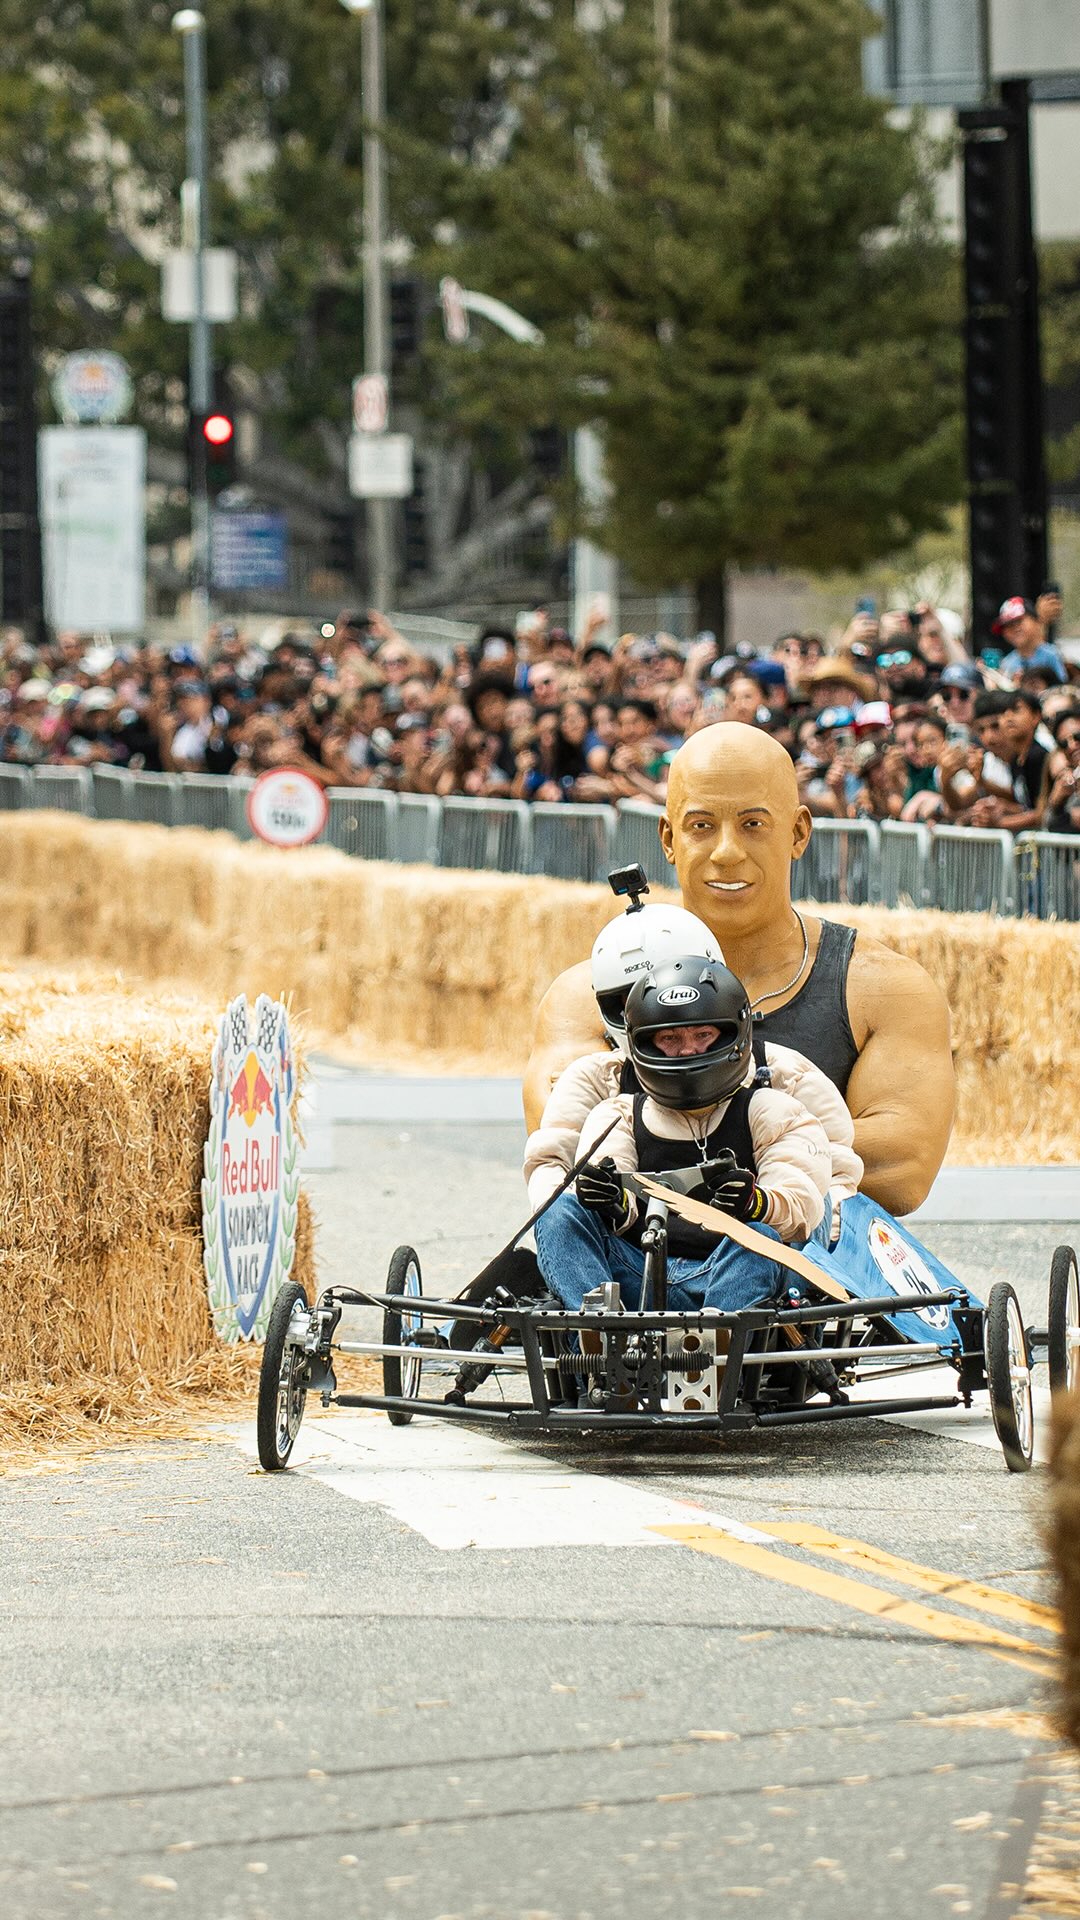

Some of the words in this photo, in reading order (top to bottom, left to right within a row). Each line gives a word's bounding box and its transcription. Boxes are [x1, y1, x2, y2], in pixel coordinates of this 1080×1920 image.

[662, 989, 692, 1002] Arai
[222, 1139, 248, 1195] Red
[251, 1136, 279, 1192] Bull
[229, 1205, 270, 1248] SOAPBOX
[236, 1253, 260, 1296] RACE
